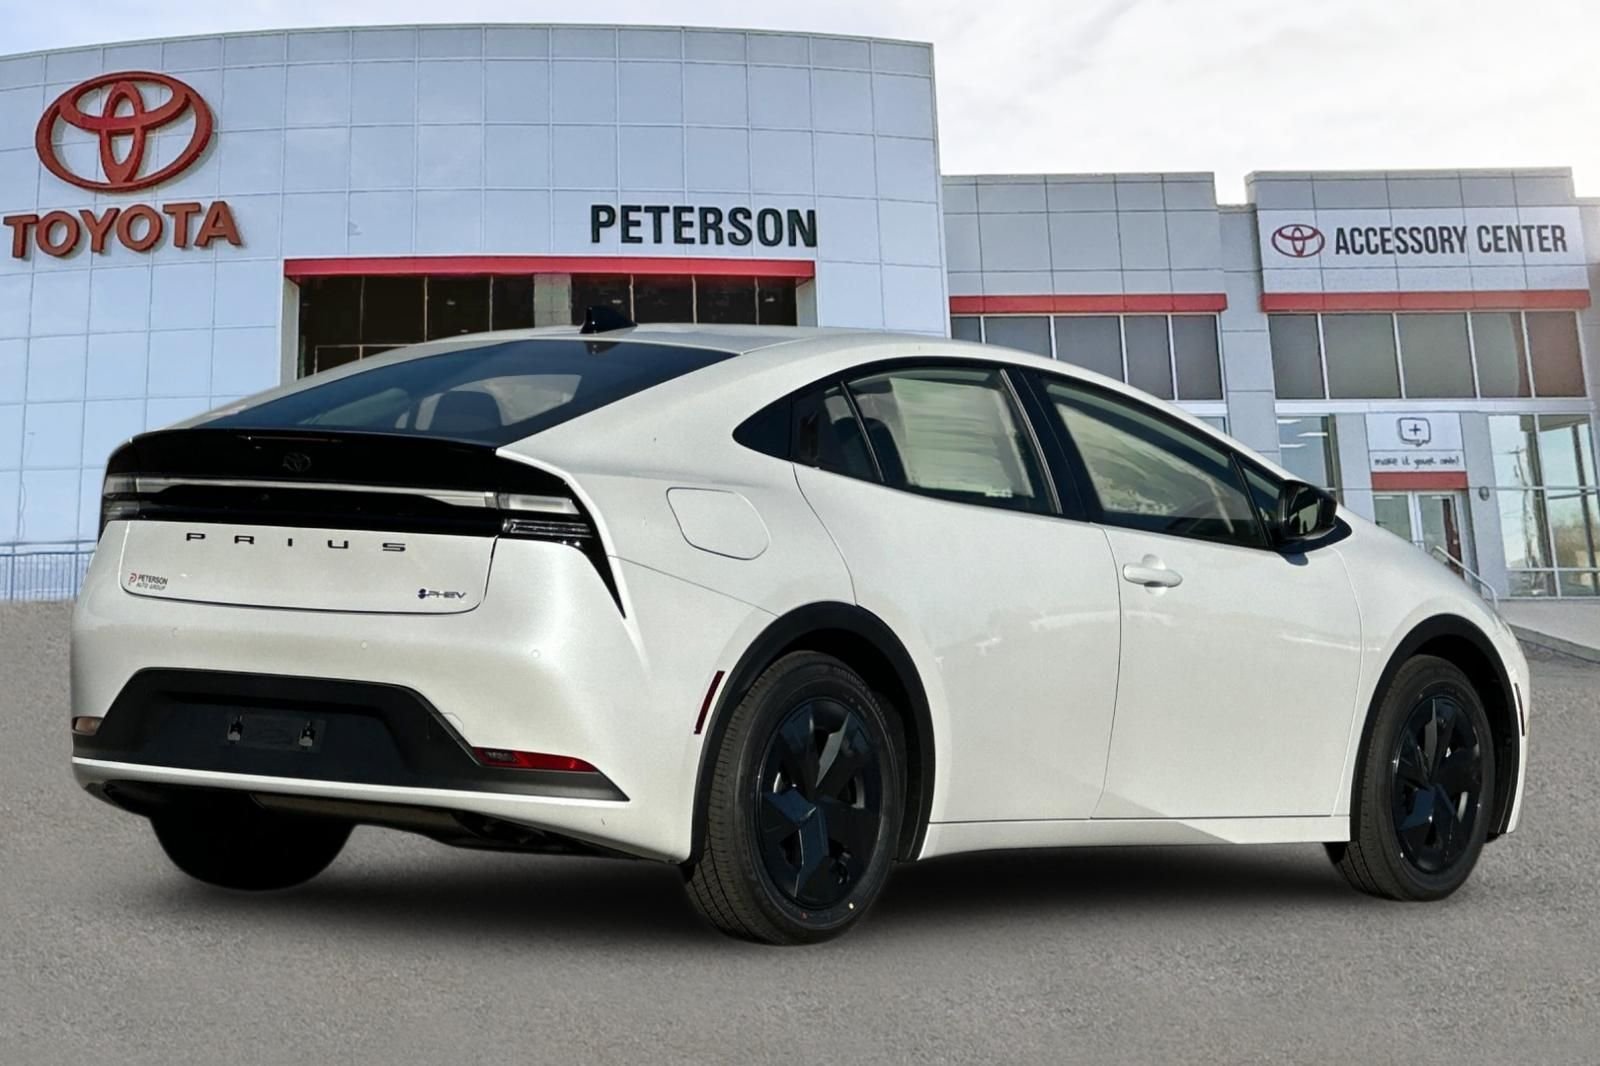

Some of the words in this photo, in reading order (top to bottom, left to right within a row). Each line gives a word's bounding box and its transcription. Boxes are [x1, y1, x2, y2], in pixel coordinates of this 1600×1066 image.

[3, 201, 242, 258] TOYOTA
[591, 205, 817, 247] PETERSON
[1335, 225, 1467, 255] ACCESSORY
[1477, 225, 1568, 253] CENTER
[186, 532, 406, 552] PRIUS
[138, 574, 168, 585] PETERSON
